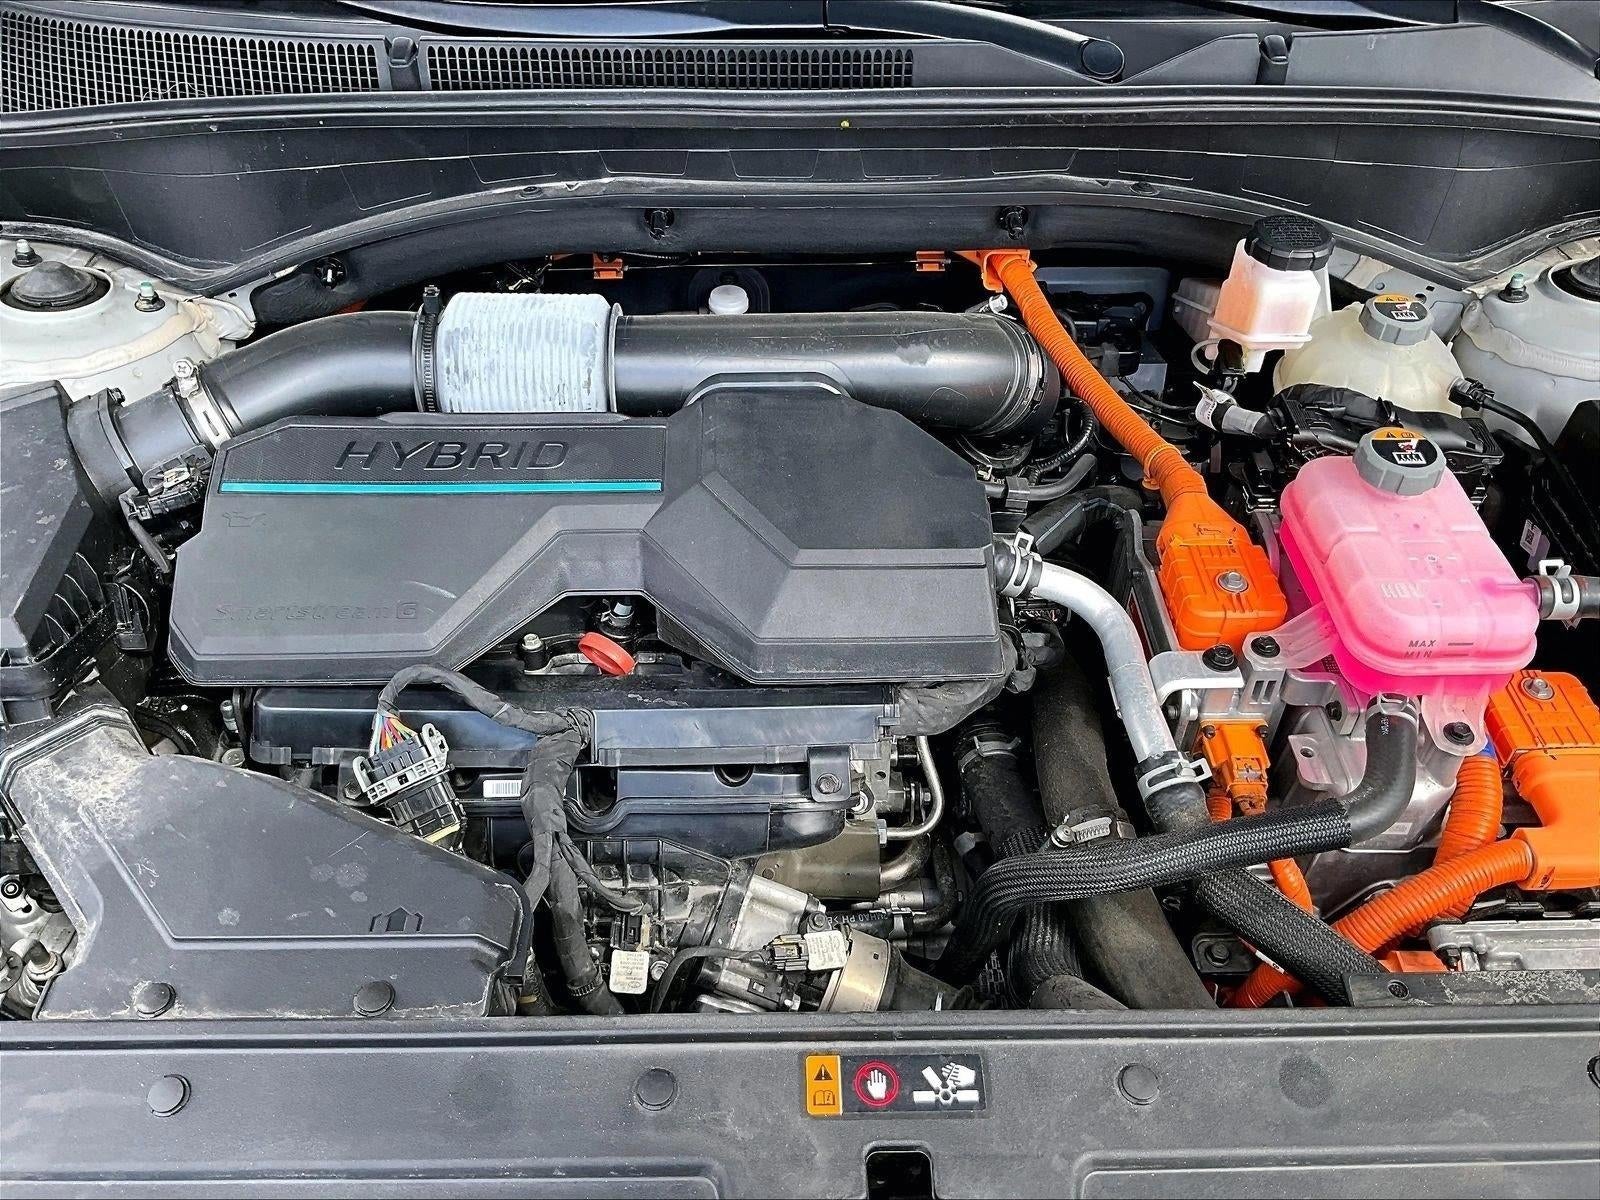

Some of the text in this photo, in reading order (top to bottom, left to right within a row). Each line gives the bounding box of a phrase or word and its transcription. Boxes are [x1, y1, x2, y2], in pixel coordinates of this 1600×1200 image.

[333, 440, 570, 471] HYBRID
[1408, 639, 1437, 648] MAX
[1403, 650, 1433, 659] MIN
